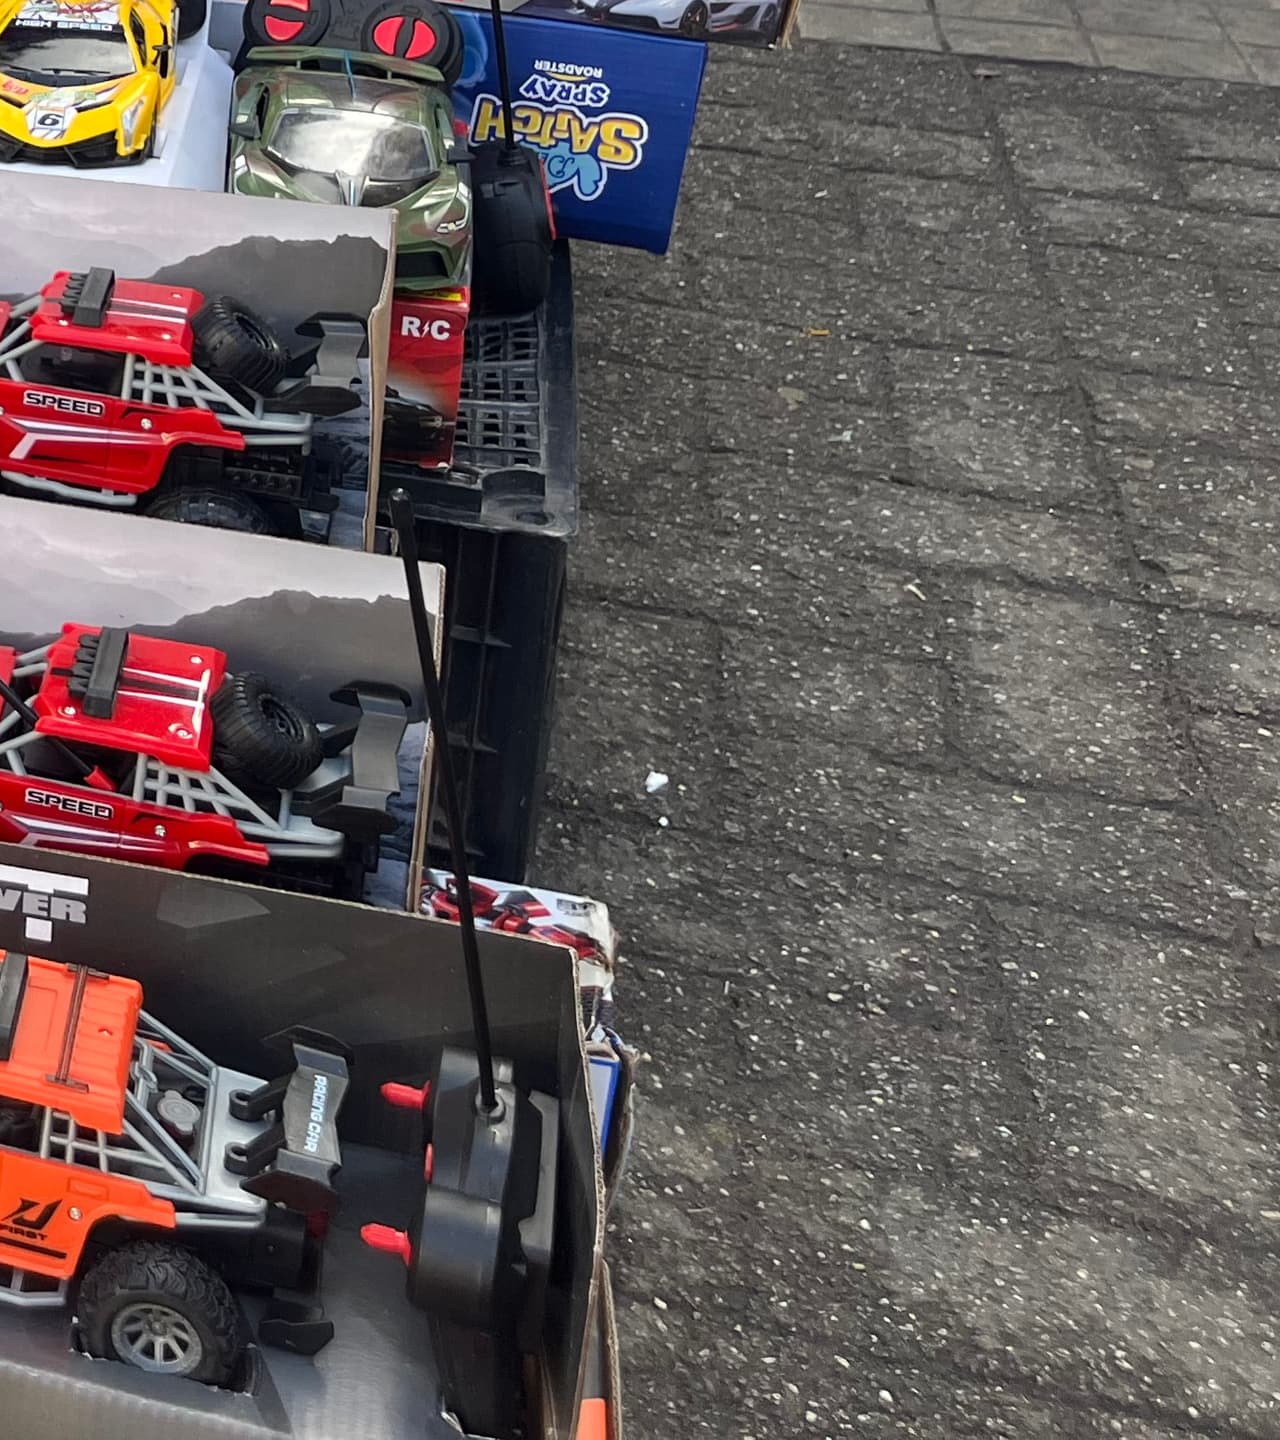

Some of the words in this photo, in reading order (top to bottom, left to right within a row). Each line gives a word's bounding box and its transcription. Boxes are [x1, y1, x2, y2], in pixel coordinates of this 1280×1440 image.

[14, 17, 52, 28] HIGH
[56, 20, 113, 32] SPEED
[534, 58, 603, 79] ROADSTER
[520, 73, 611, 107] SPRAY
[37, 112, 62, 127] 6
[22, 390, 105, 417] SPEED
[24, 788, 114, 820] SPEED
[312, 1072, 329, 1123] RACING
[302, 1121, 319, 1155] CAR
[0, 1221, 49, 1241] FIRST
